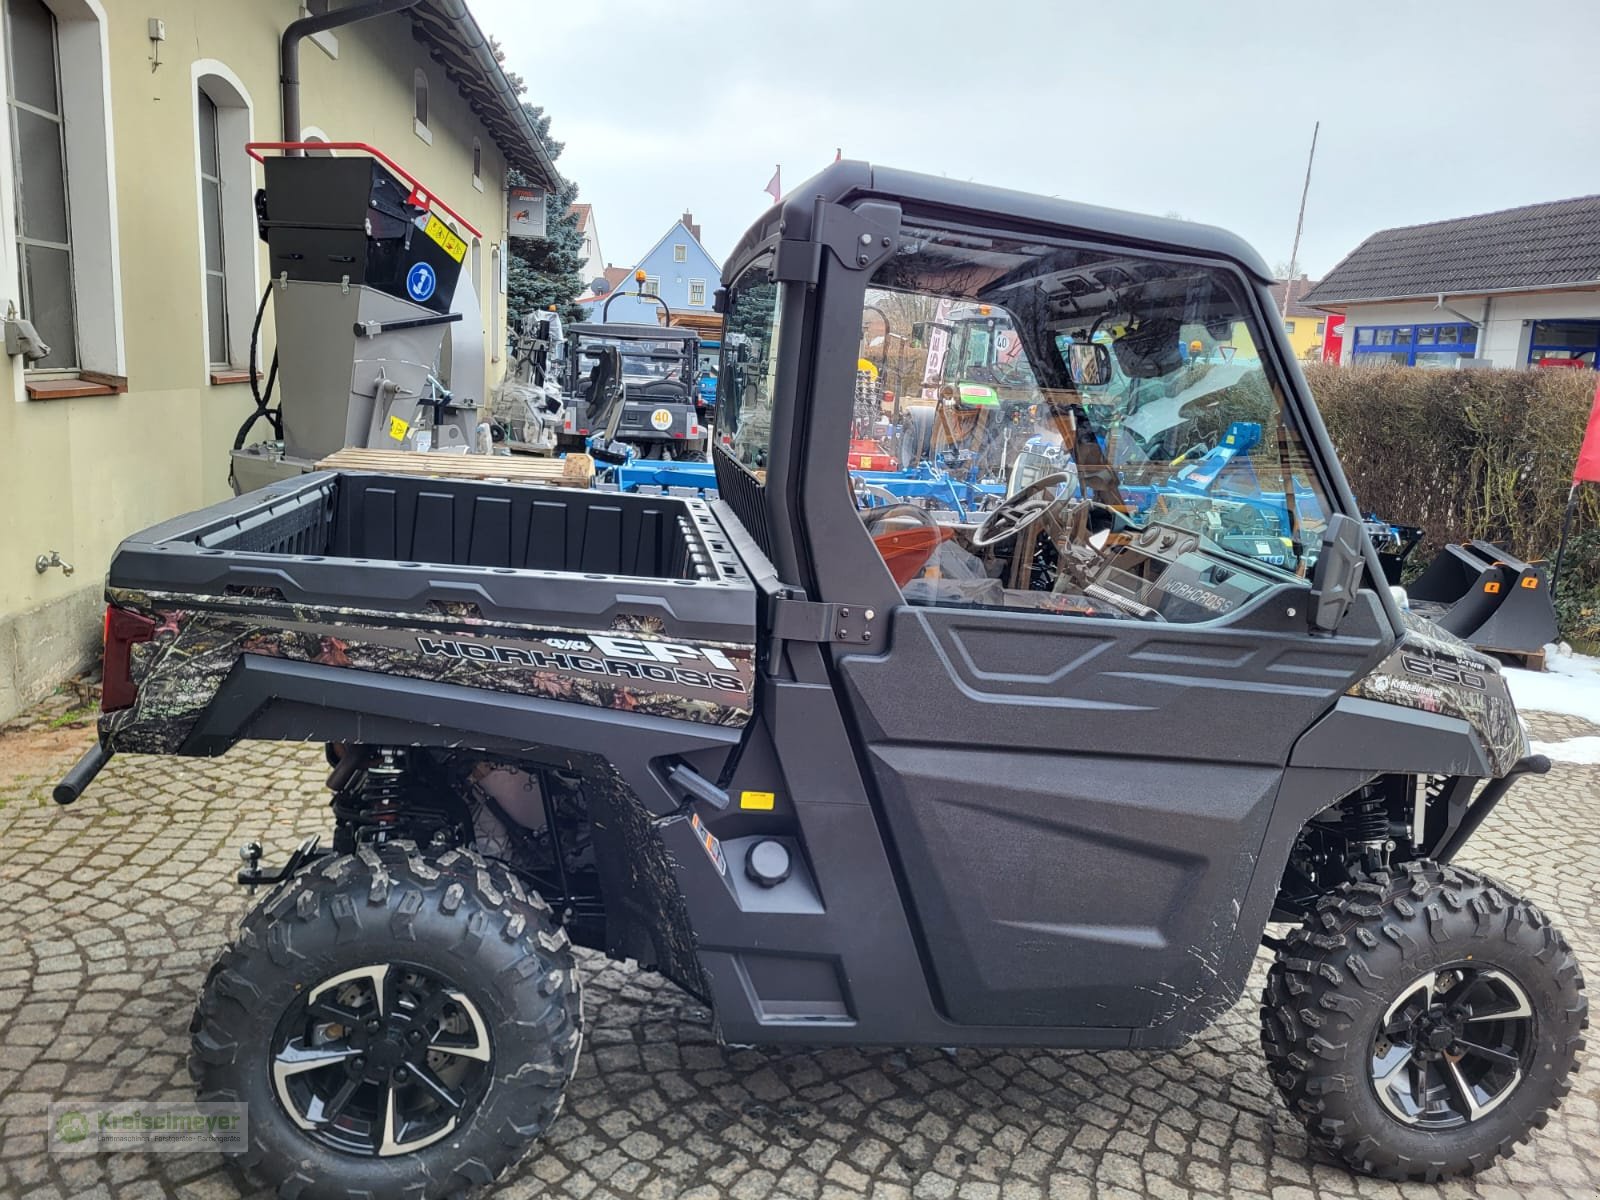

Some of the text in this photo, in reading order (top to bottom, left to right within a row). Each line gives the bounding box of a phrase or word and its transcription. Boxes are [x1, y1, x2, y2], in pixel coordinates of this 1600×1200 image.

[997, 337, 1007, 349] 40
[655, 412, 669, 424] 40
[416, 637, 747, 693] WORKCROSS
[587, 635, 738, 672] EFI
[1456, 658, 1485, 671] V-TWIN
[1401, 655, 1487, 691] 650
